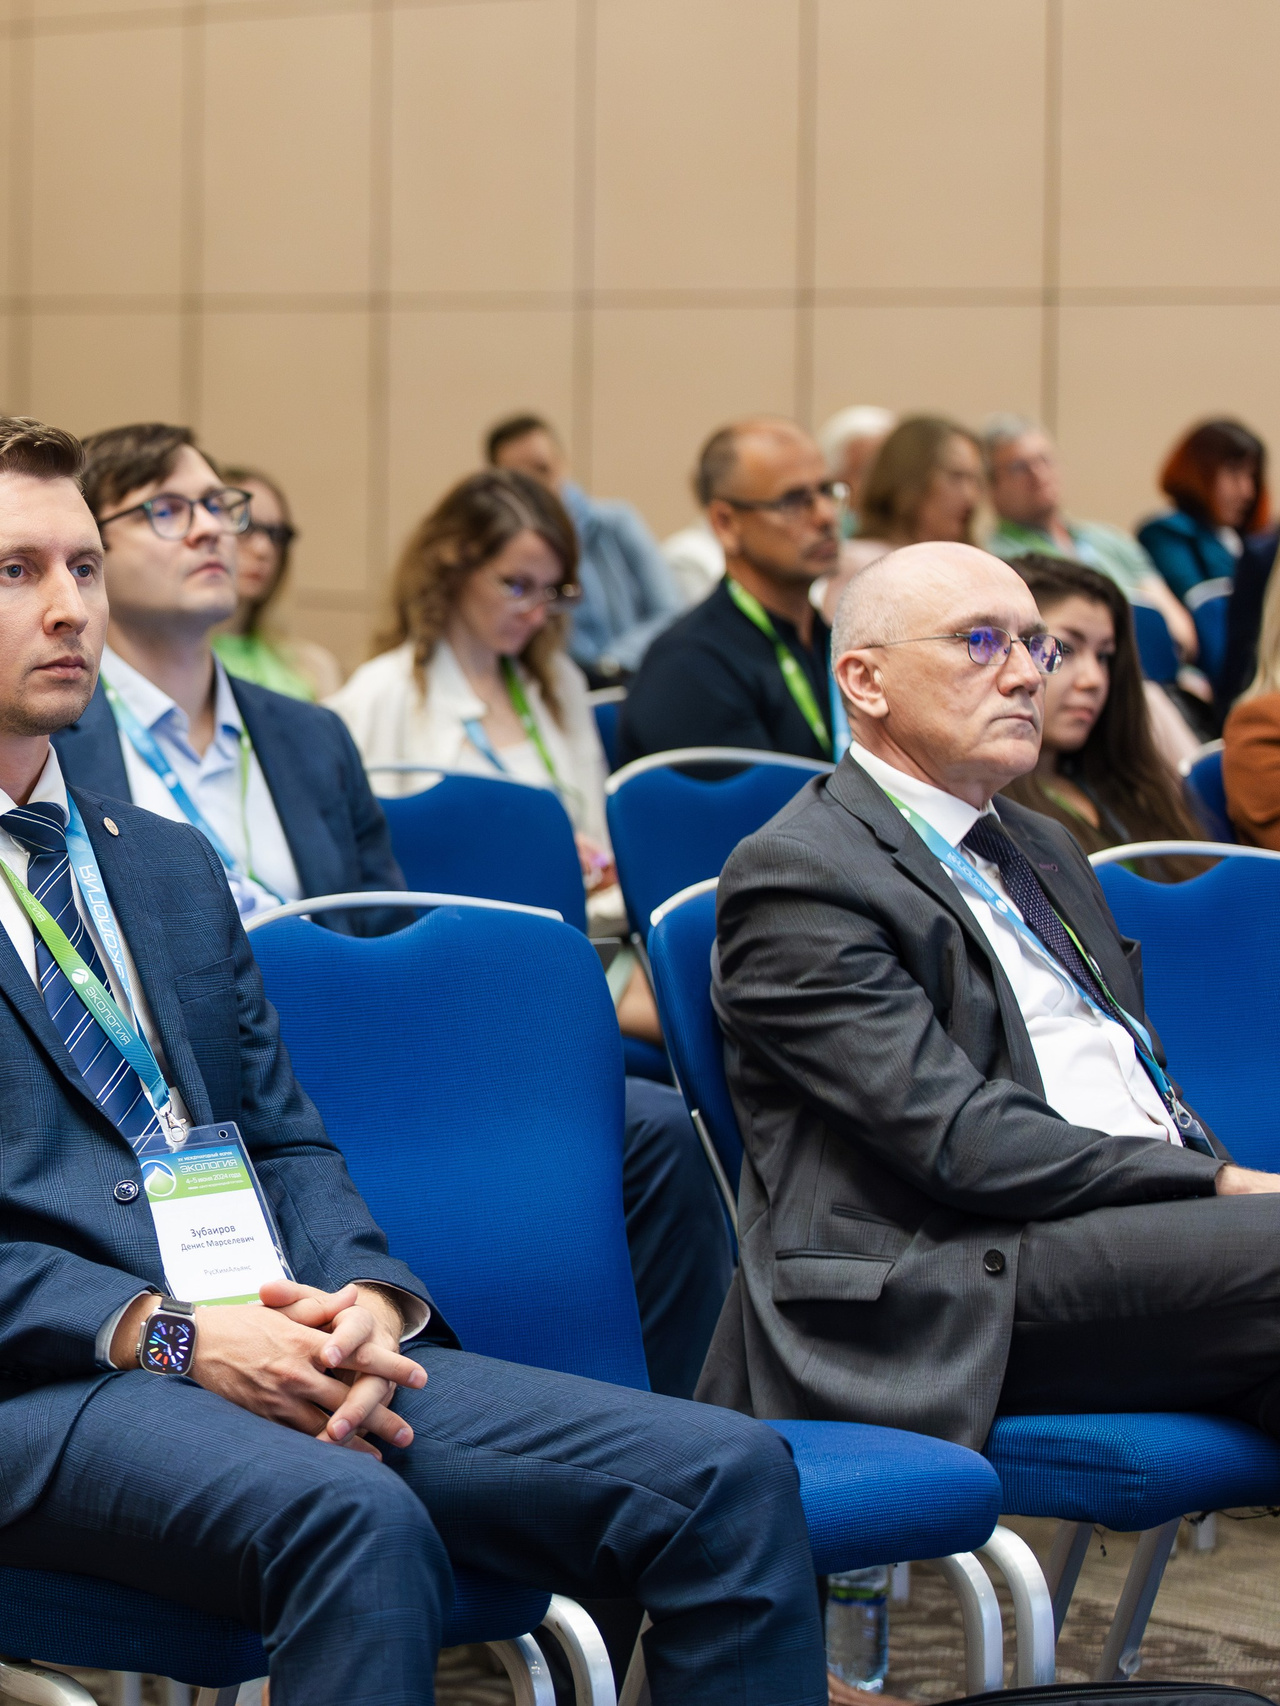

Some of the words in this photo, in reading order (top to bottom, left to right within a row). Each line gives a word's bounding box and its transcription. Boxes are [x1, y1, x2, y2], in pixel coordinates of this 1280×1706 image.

[85, 986, 131, 1045] ЭКОЛОГИЯ
[179, 1159, 238, 1173] ЭКОЛОГИЯ
[213, 1173, 229, 1181] 2024
[190, 1225, 236, 1238] Зубаиров
[181, 1243, 205, 1252] Денис
[206, 1236, 255, 1248] Марселевич
